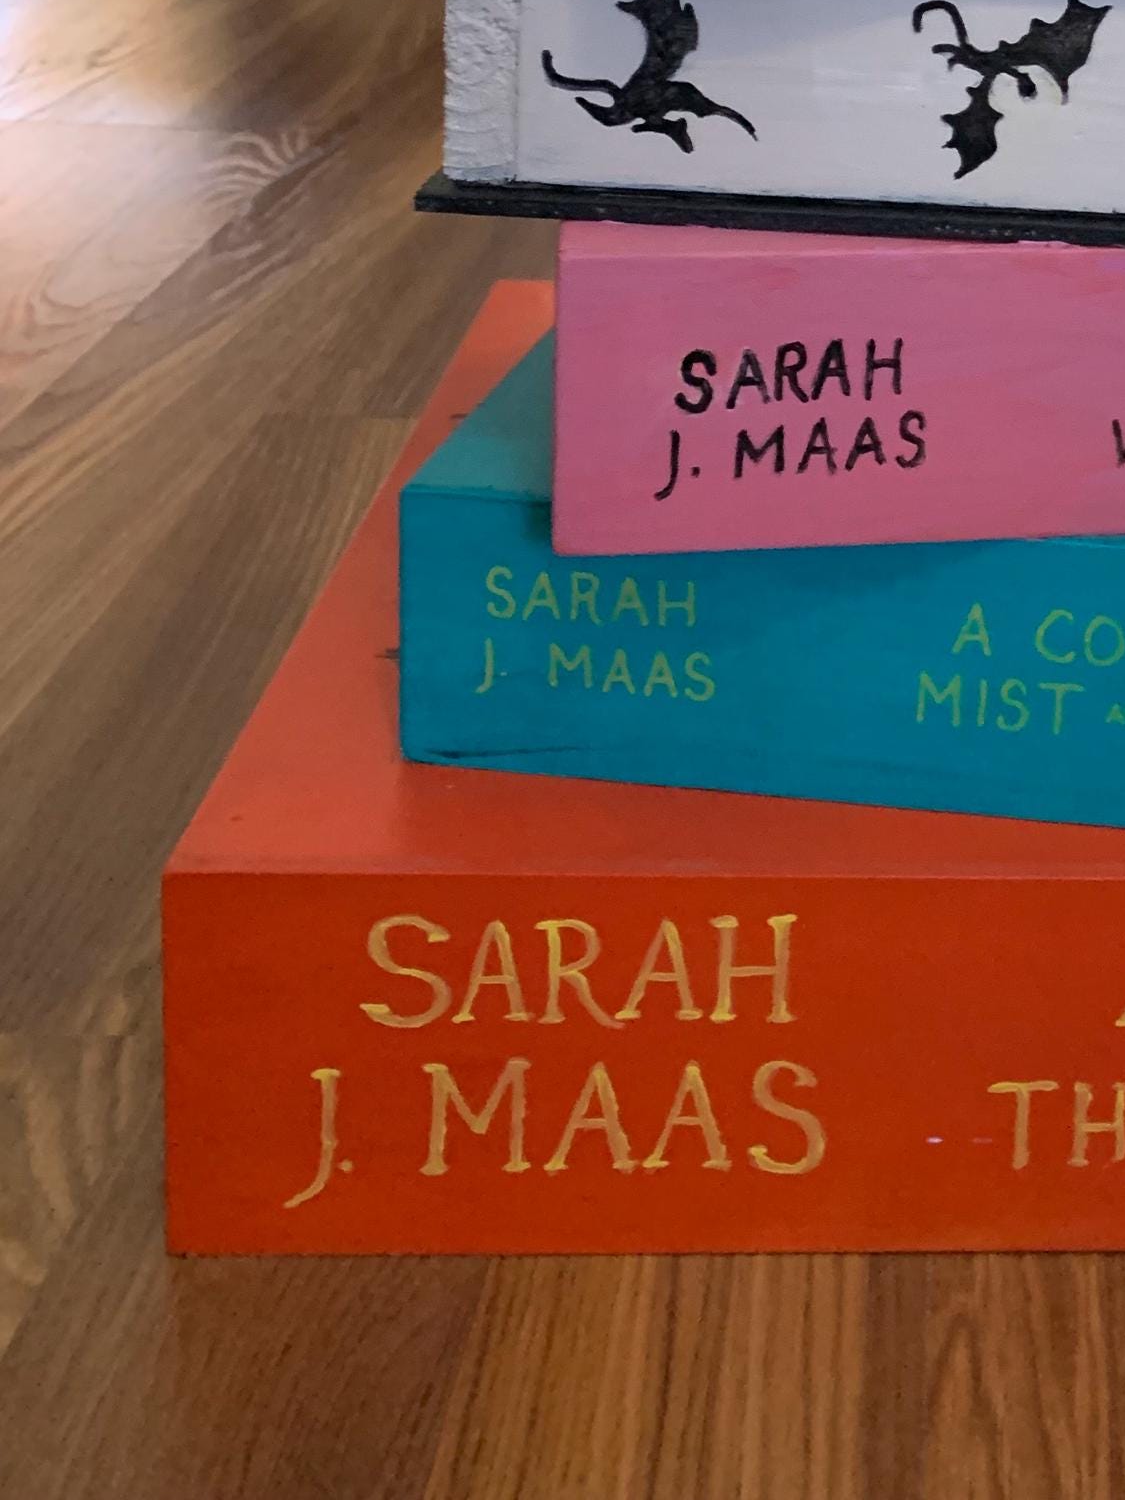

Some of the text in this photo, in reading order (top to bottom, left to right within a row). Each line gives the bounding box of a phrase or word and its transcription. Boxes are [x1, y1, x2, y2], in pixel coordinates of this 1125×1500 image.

[674, 337, 904, 415] SARAH
[653, 409, 927, 502] J. MAAS
[485, 565, 697, 628] SARAH
[951, 602, 992, 657] A
[548, 642, 717, 703] MAAS
[915, 670, 1088, 736] MIST
[359, 913, 799, 1030] SARAH
[282, 1056, 830, 1210] J. MAAS
